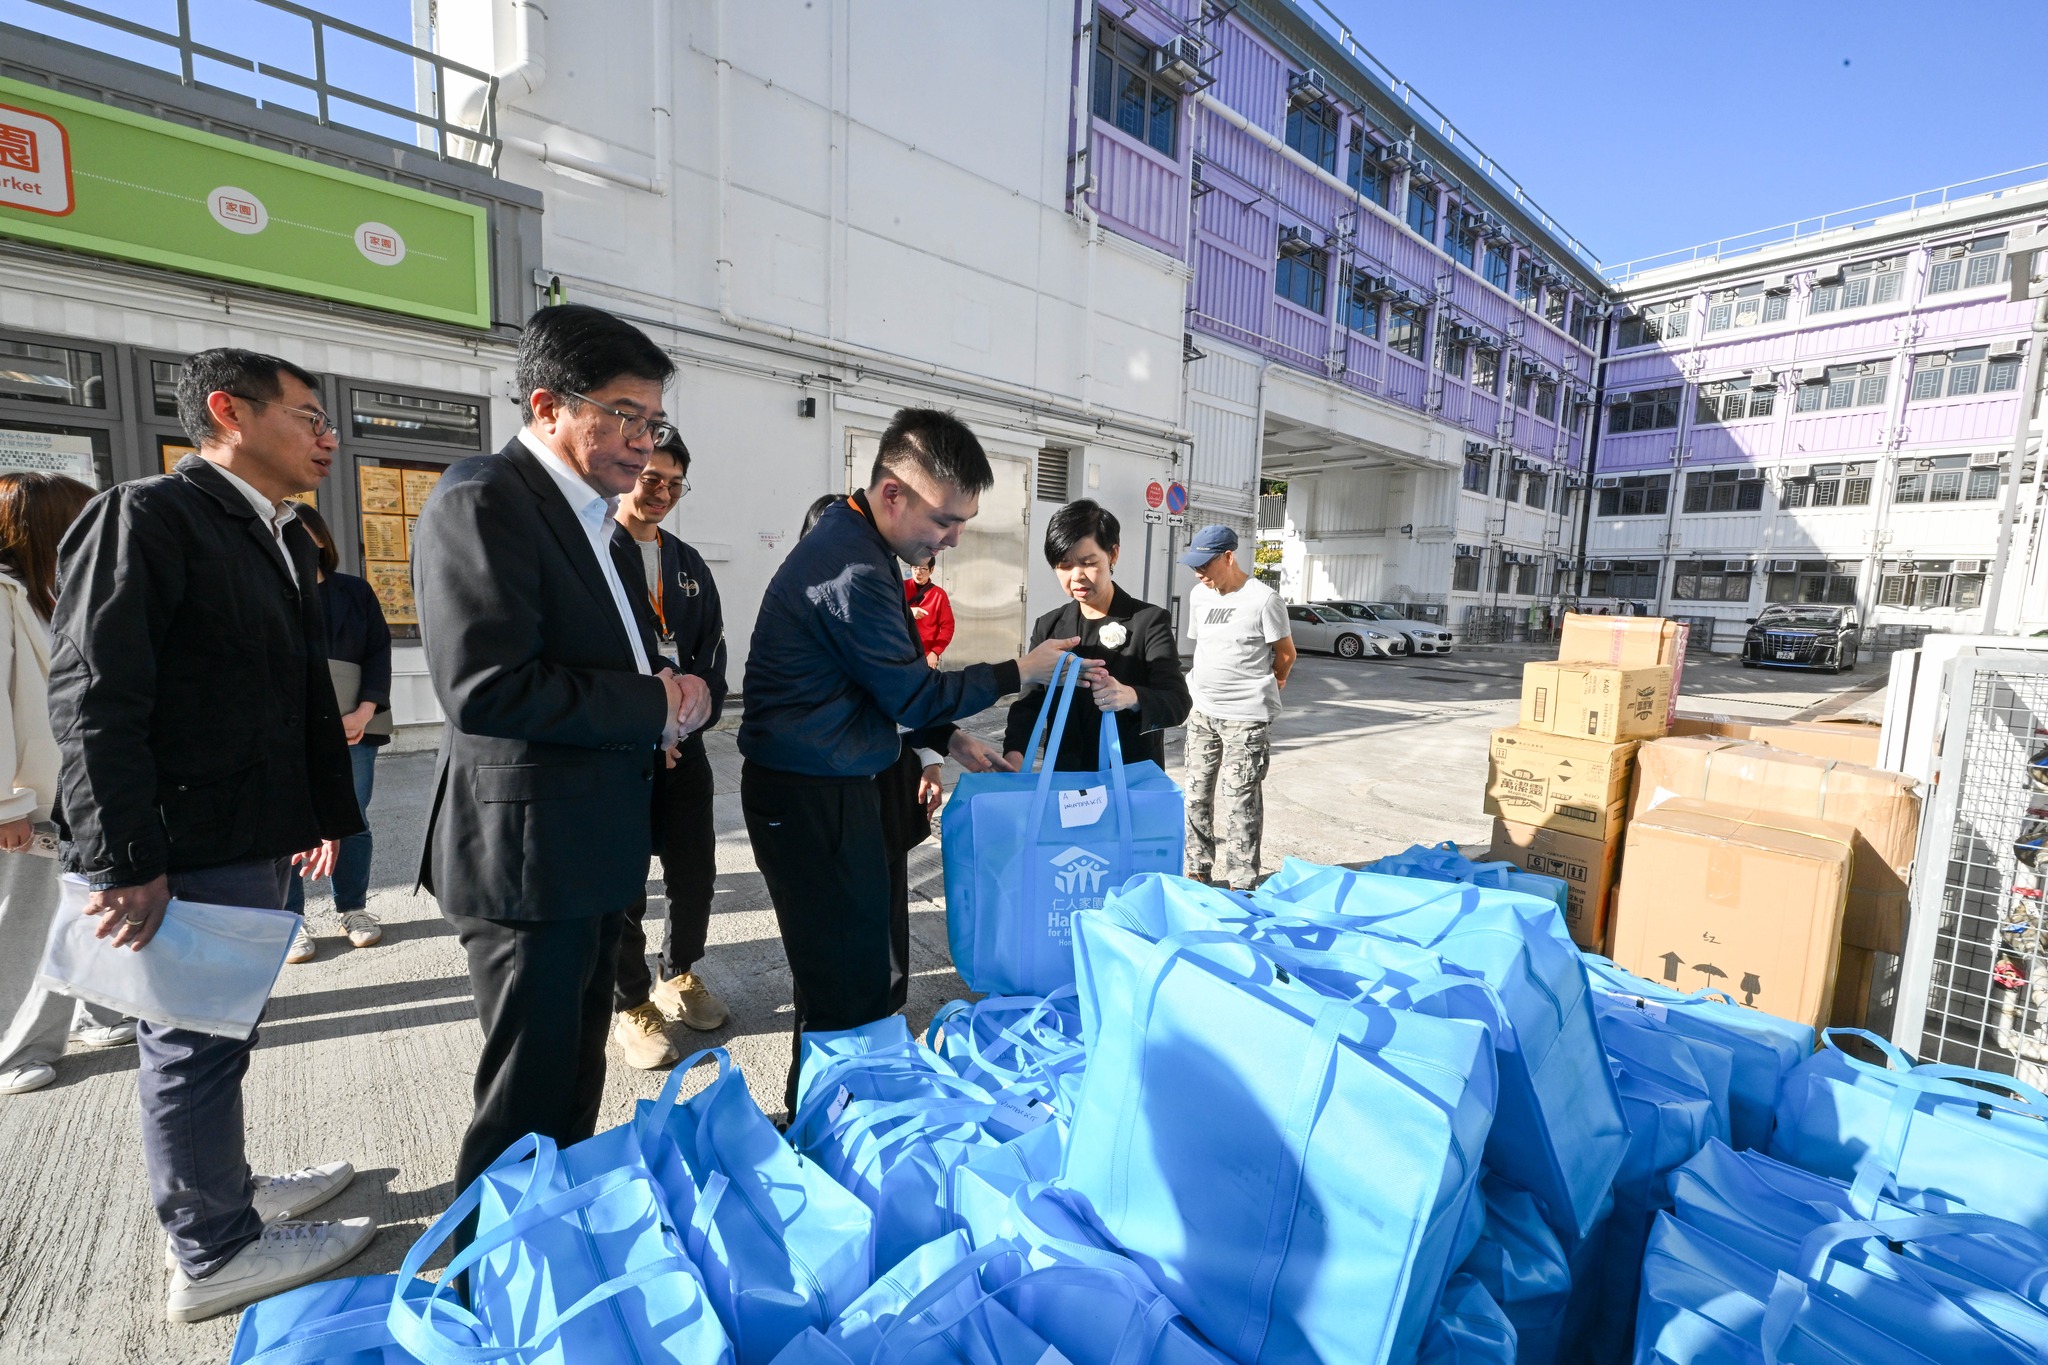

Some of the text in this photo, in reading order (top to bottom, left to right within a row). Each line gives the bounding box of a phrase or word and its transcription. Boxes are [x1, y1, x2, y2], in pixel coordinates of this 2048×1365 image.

[0, 176, 42, 195] rket
[226, 201, 251, 216] 家園
[370, 236, 391, 249] 家園
[1204, 607, 1237, 625] NIKE
[1533, 856, 1541, 866] 6
[1052, 897, 1105, 911] 仁人家園
[1048, 911, 1071, 928] Ha
[1048, 928, 1061, 937] for
